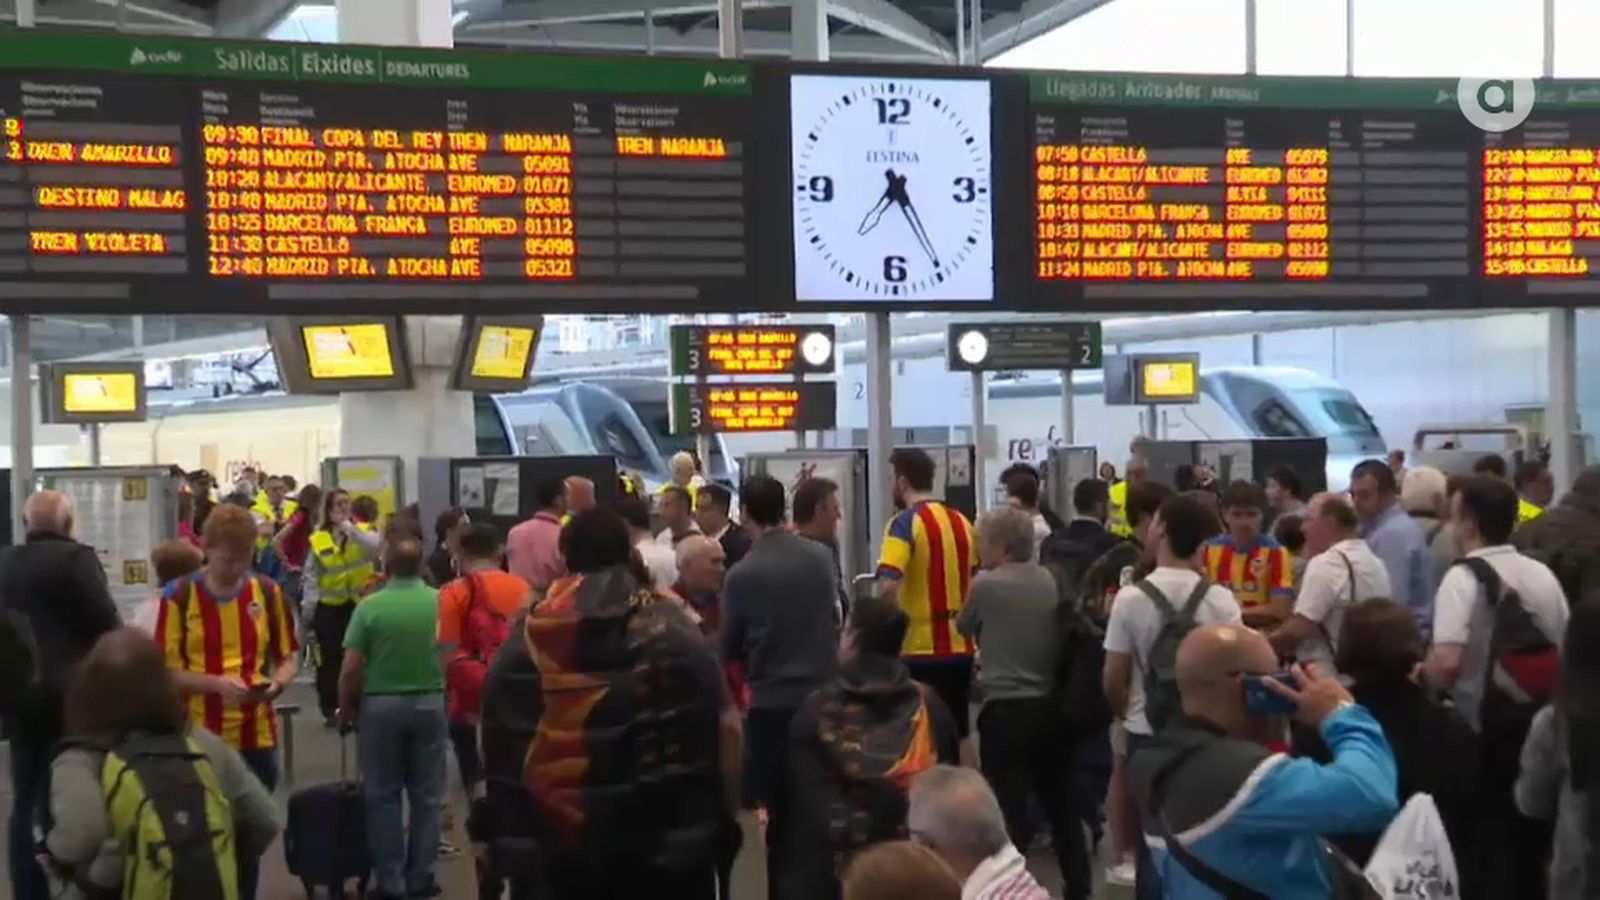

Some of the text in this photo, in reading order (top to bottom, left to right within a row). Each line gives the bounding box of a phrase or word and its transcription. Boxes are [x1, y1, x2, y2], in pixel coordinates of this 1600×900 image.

[215, 49, 470, 78] Salidas Eixides DEPARTURES
[1046, 79, 1115, 101] Llegadas
[873, 98, 911, 125] 12
[261, 128, 313, 145] FINAL
[323, 130, 364, 146] COPA
[374, 131, 403, 148] DEL
[413, 133, 442, 148] REY
[449, 133, 486, 150] TREN
[504, 135, 570, 151] NARANJA
[618, 138, 653, 153] TREN
[661, 139, 724, 155] NARANJA
[81, 146, 171, 162] AMARILLO
[263, 149, 326, 167] MADRID
[335, 151, 372, 168] PTA.
[386, 153, 445, 169] ATOCHA
[866, 151, 920, 163] FESTINA
[448, 175, 515, 192] EUROMED
[809, 176, 834, 202] 9
[952, 177, 976, 203] 3
[40, 189, 184, 207] DESTINO MALAG
[264, 193, 327, 210] MADRID
[336, 194, 373, 210] PTA.
[387, 195, 445, 212] ATOCHA
[450, 196, 477, 212] AVE
[209, 214, 261, 230] 10:55
[265, 214, 357, 232] BARCELONA
[449, 217, 517, 233] EUROMED
[32, 233, 163, 251] TREN VIOLETA
[267, 257, 328, 274] MADRID
[338, 258, 375, 274] PTA.
[388, 259, 447, 275] ATOCHA
[451, 259, 479, 275] AVE
[883, 255, 907, 282] 6
[689, 350, 700, 369] 3
[1081, 345, 1092, 365] 2
[690, 408, 701, 428] 3
